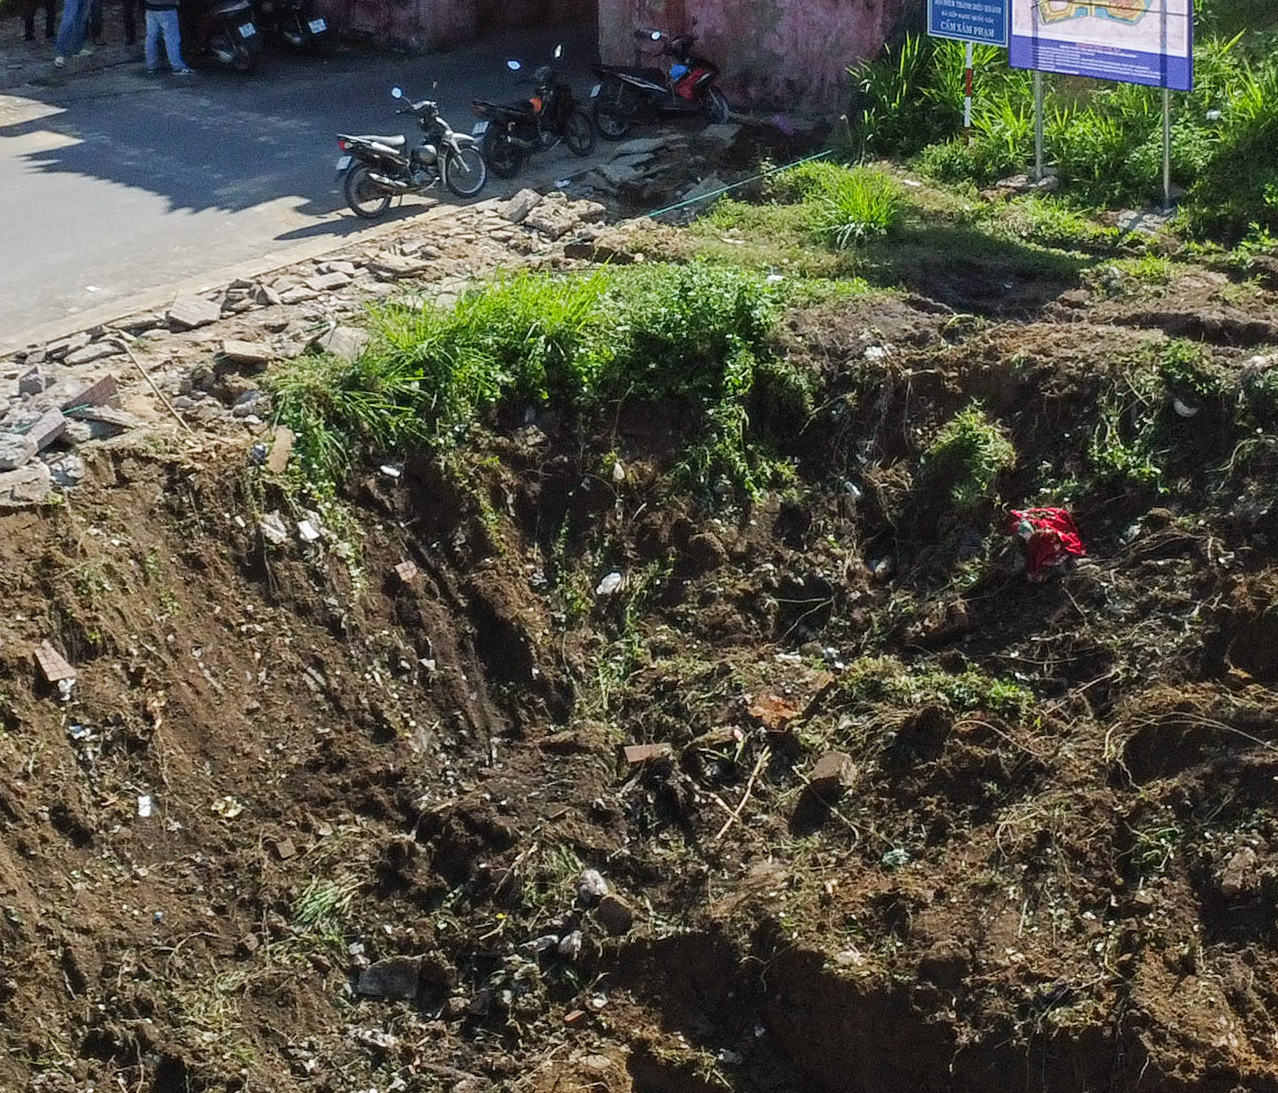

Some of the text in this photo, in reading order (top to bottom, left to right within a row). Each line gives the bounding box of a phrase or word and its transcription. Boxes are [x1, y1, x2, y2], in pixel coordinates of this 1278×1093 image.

[940, 18, 995, 38] CẤM XÂM PHẠM
